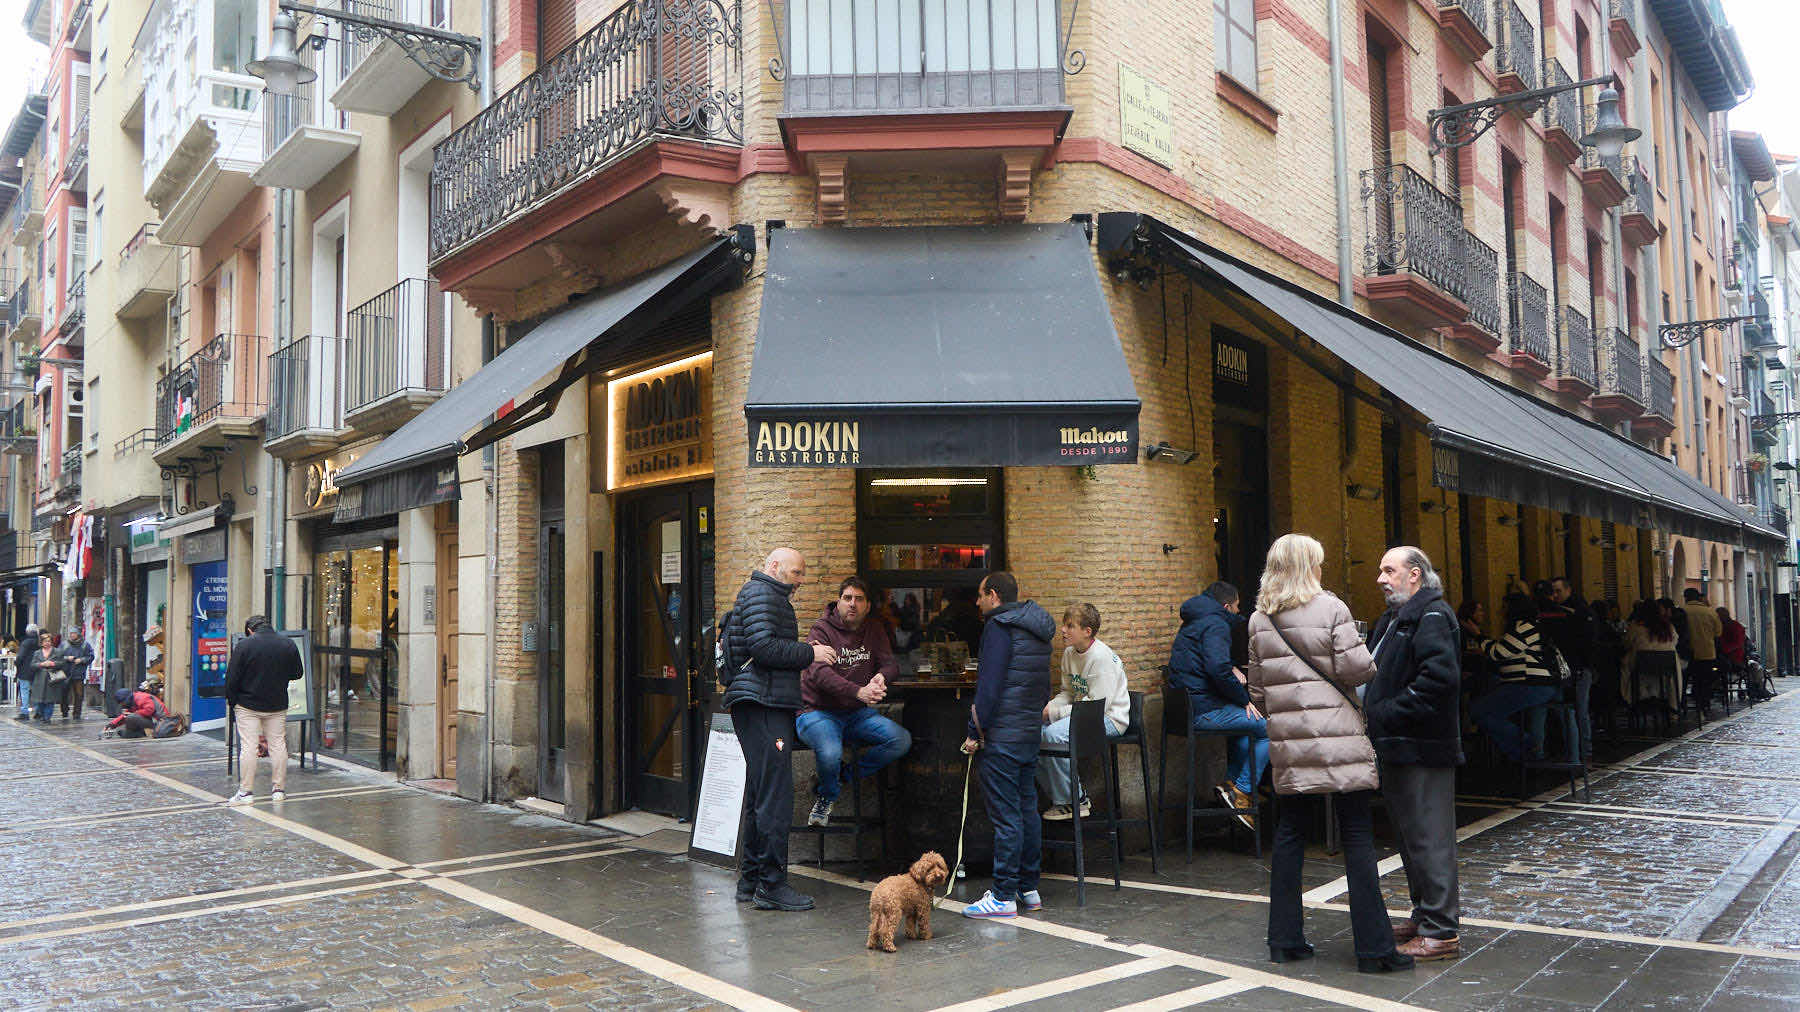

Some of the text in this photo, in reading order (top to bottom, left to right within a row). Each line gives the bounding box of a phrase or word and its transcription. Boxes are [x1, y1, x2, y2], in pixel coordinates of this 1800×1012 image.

[1217, 343, 1248, 372] ADOKIN
[625, 366, 703, 433] ADOKIN
[756, 421, 859, 452] ADOKIN
[1060, 427, 1129, 444] Mahou
[755, 451, 860, 464] GASTROBAR
[1061, 445, 1128, 456] DESDE 1890
